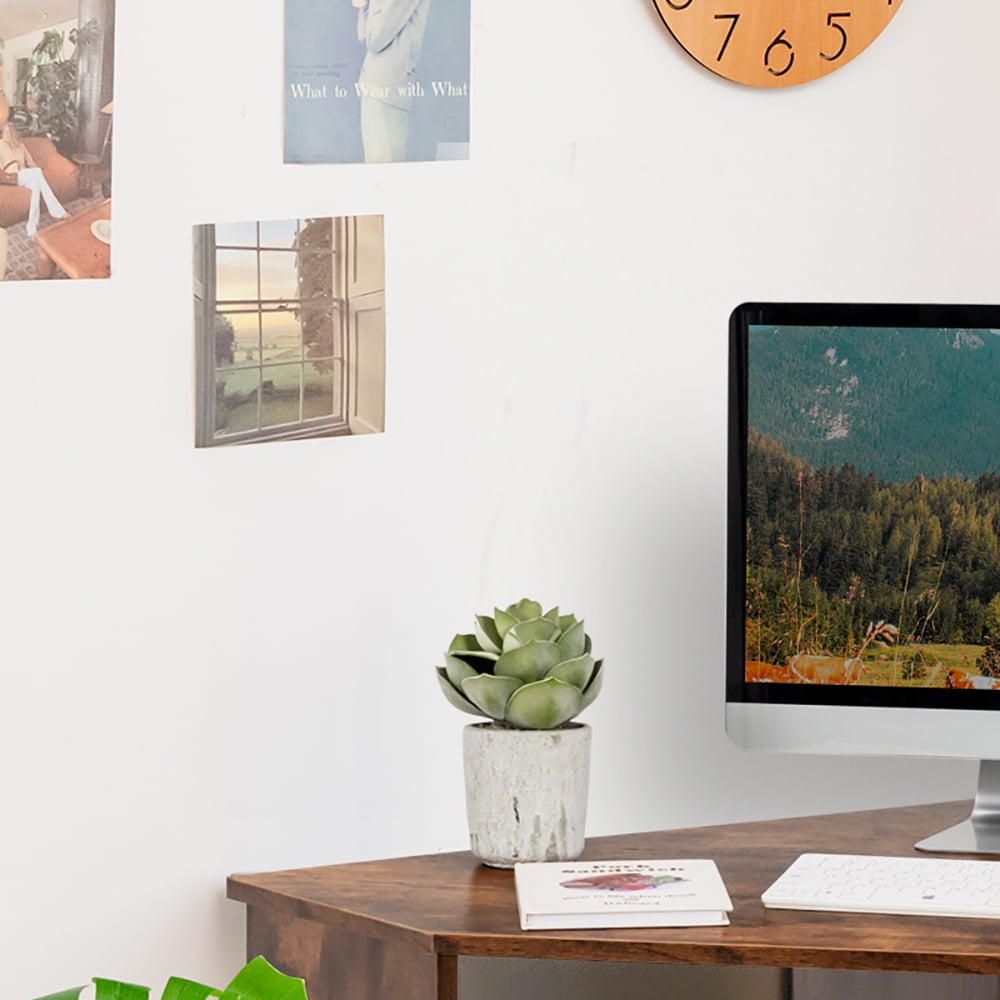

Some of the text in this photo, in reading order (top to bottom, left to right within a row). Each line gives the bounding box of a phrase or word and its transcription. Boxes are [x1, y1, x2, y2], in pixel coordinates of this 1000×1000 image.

[714, 14, 740, 61] 7
[764, 29, 795, 76] 6
[820, 12, 851, 61] 5
[290, 81, 467, 98] What to Wear with What
